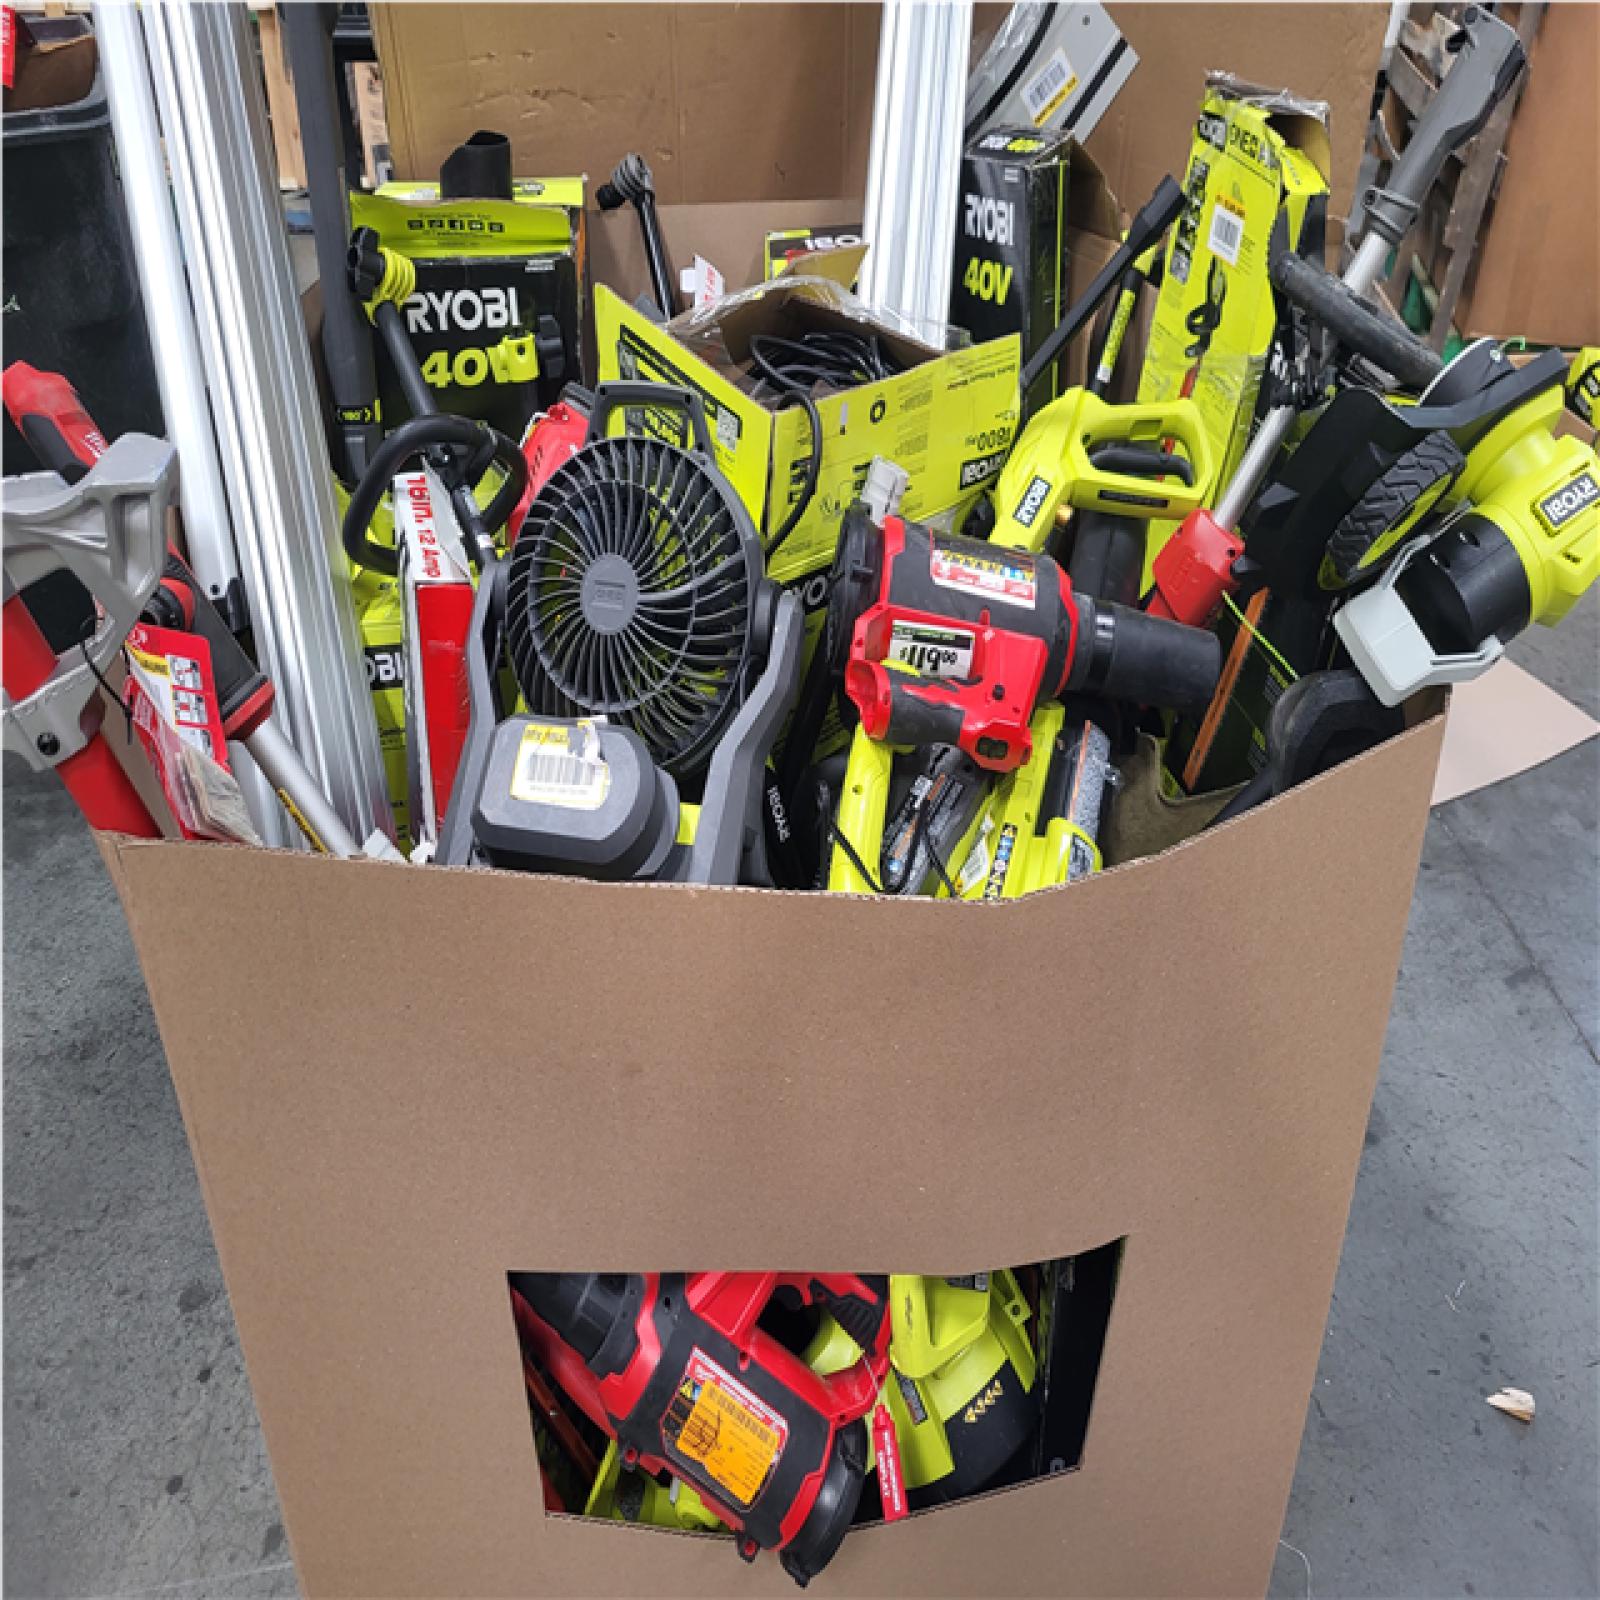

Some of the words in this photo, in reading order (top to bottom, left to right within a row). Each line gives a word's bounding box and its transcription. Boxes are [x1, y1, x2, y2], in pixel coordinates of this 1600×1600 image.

[963, 193, 1015, 247] RYOBI
[962, 256, 1013, 306] 40V
[404, 286, 522, 334] RYOBI
[1016, 478, 1050, 524] RYOBI
[1543, 475, 1599, 522] RYOBI
